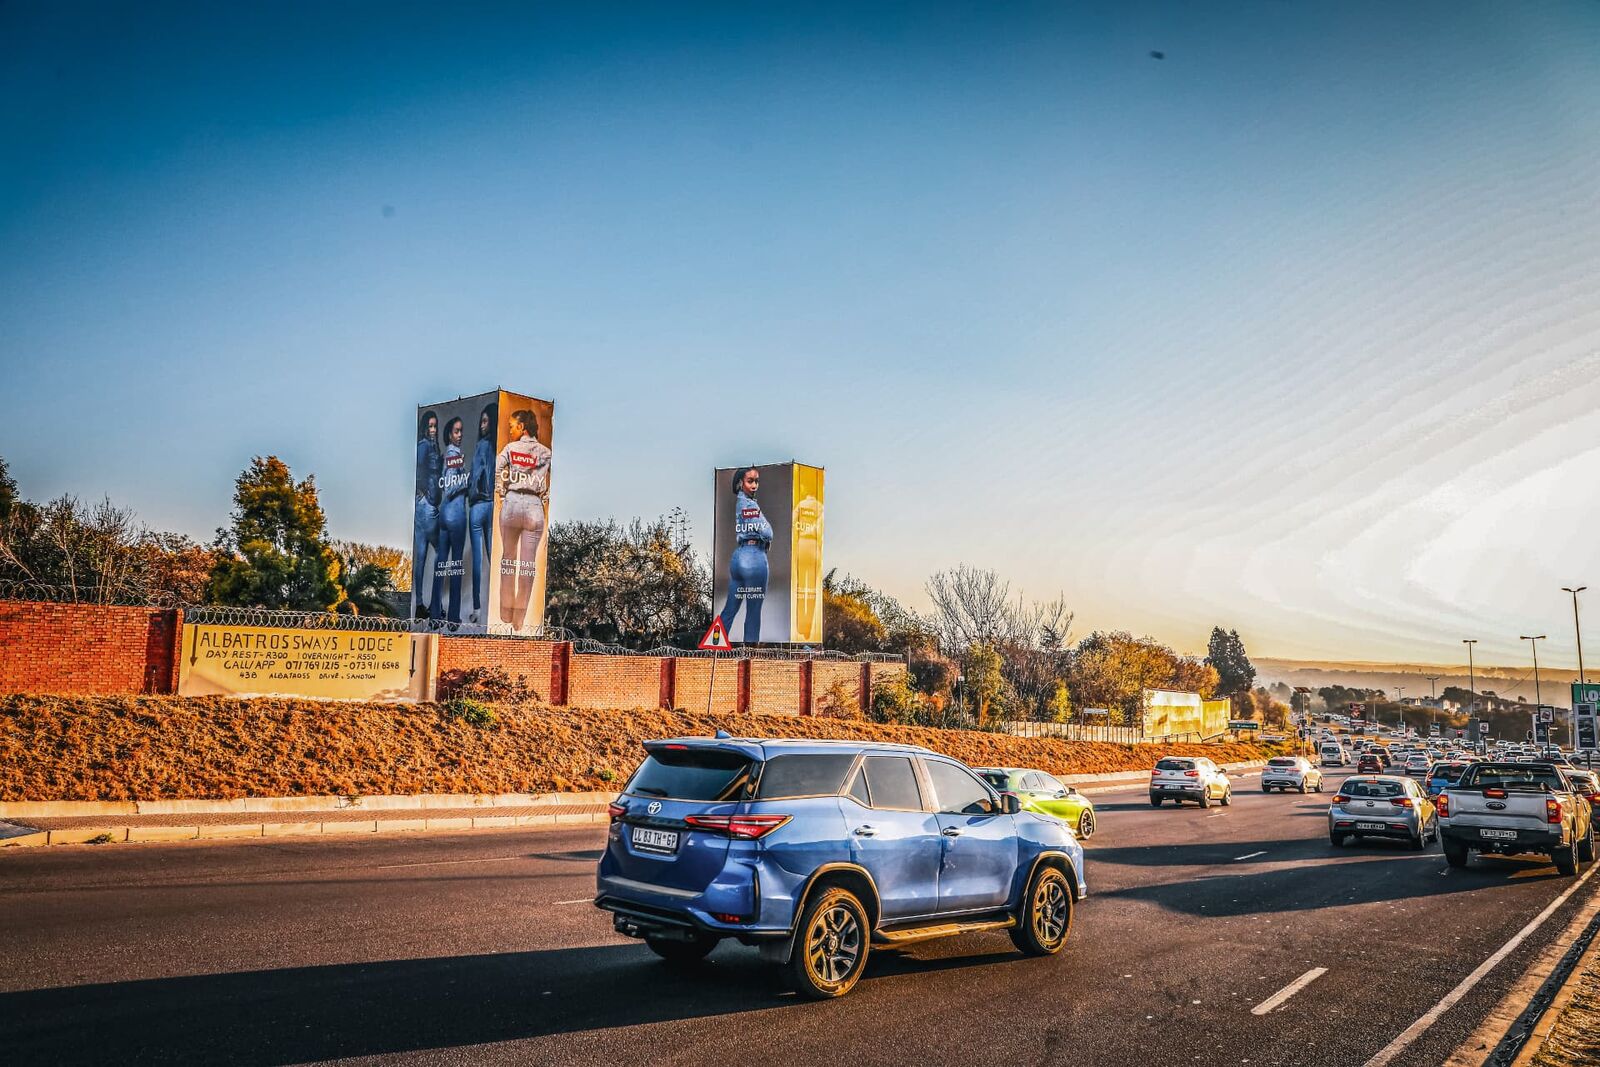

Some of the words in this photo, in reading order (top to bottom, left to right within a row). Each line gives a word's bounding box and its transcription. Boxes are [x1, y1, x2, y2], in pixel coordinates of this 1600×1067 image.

[438, 471, 470, 488] CURVY
[501, 470, 544, 487] CURVY
[735, 522, 767, 533] CURVY
[350, 637, 393, 652] LODGE
[206, 650, 229, 659] DAY
[224, 660, 276, 670] CALL/APP
